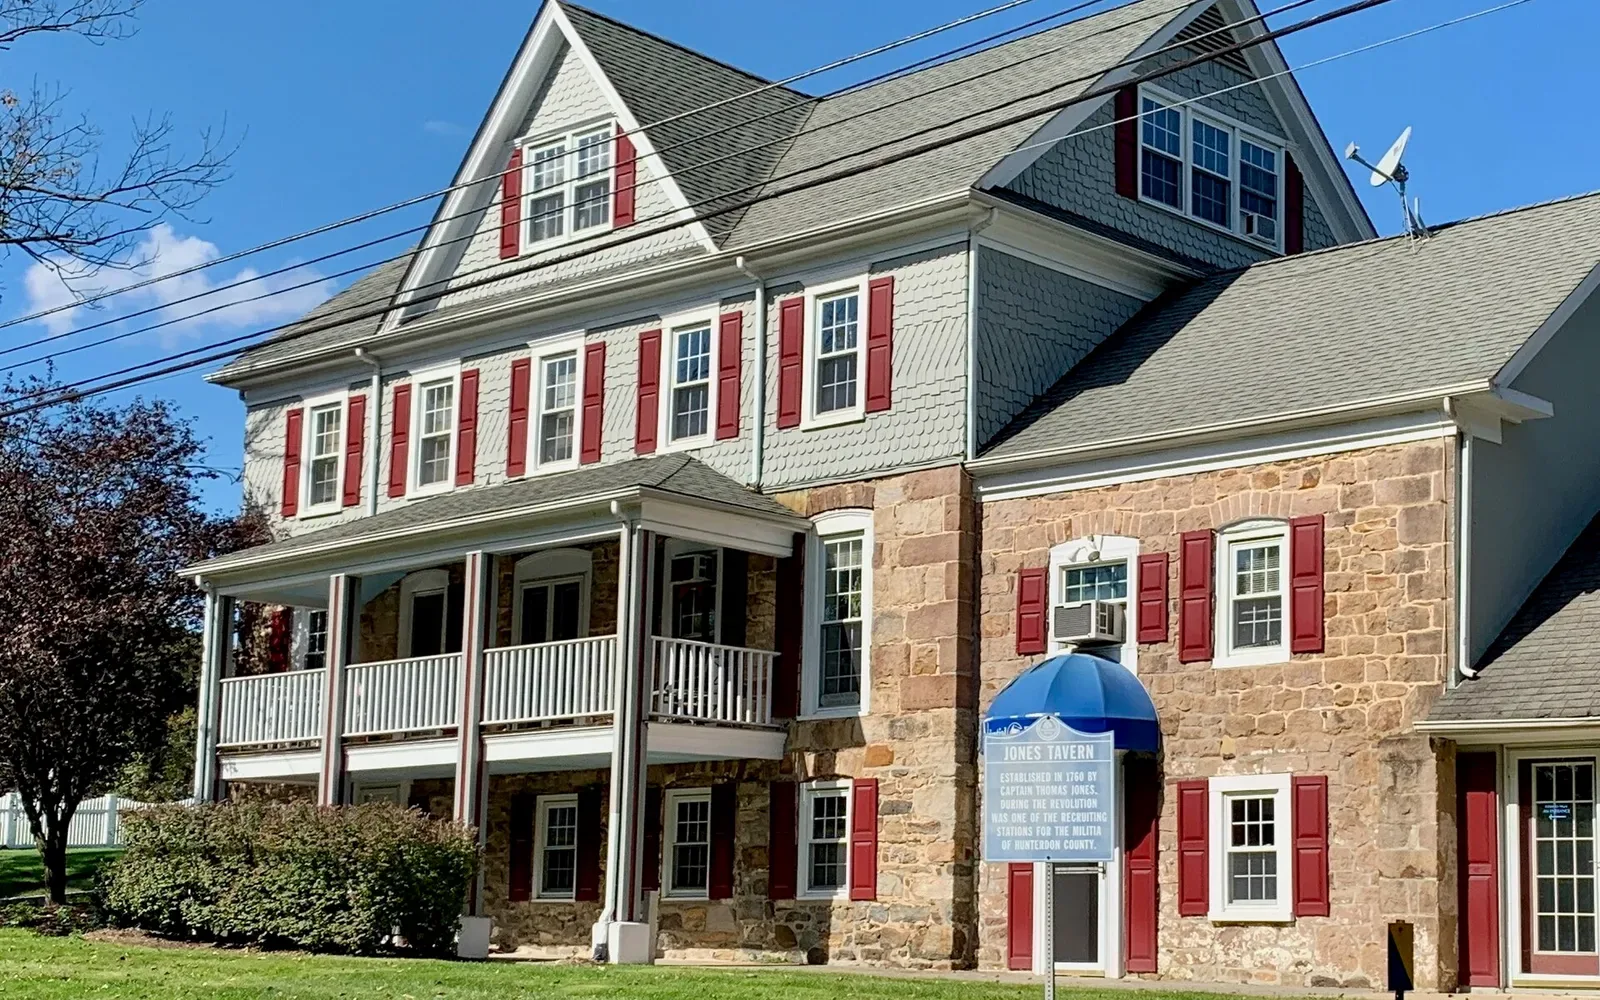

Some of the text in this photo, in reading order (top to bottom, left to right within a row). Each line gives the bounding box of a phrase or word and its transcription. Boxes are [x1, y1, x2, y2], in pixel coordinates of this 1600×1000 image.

[1003, 744, 1094, 761] JONES TAVERN
[1000, 771, 1098, 783] ESTABLISHED IN 1760 BY
[1000, 785, 1033, 796] CAPTAIN
[1036, 785, 1068, 795] THOMAS
[1000, 798, 1098, 810] DURING THE REVOLUTION
[991, 812, 1107, 823] WAS ONE OF THE RECRUITING
[996, 825, 1102, 837] STATIONS FOR THE MILITIA
[1001, 839, 1097, 850] OF HUNTERDON COUNTY.
